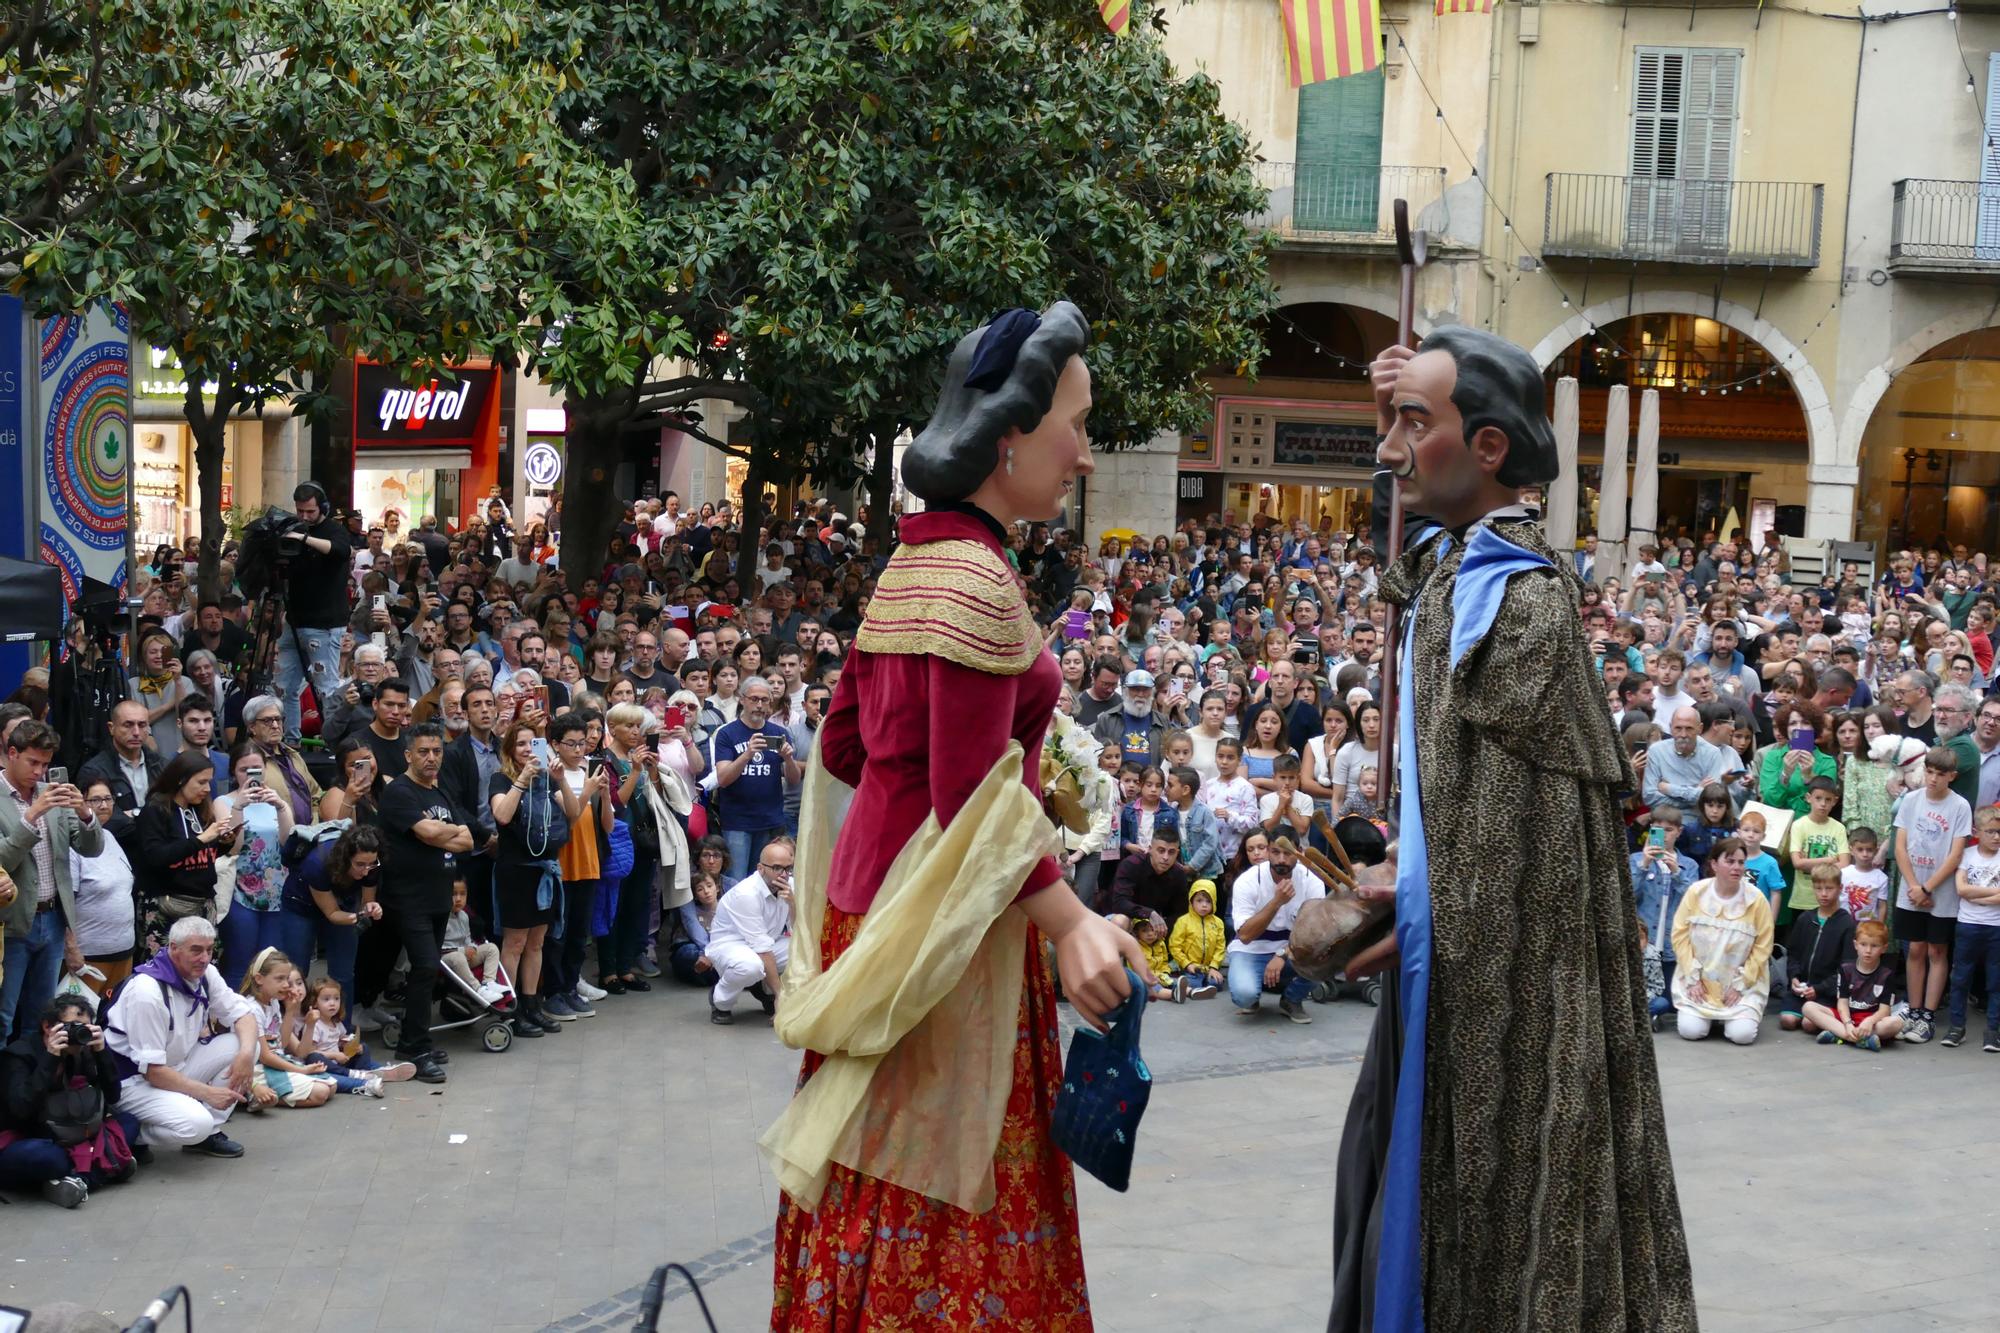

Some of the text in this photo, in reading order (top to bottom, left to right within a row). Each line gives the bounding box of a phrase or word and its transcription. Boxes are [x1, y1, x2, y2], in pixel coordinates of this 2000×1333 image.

[68, 350, 98, 380] FIRES
[97, 363, 123, 373] CIUTAT
[63, 372, 94, 414] FIGUERES
[379, 379, 471, 431] querol
[47, 391, 64, 436] CREU
[60, 415, 67, 431] DE
[46, 440, 59, 495] SANTA
[56, 432, 65, 472] CIUTAT
[62, 480, 92, 522] FIGUERES
[1181, 477, 1203, 498] BIBA
[55, 495, 68, 515] LA
[65, 514, 83, 533] DE
[82, 529, 120, 546] FESTES
[56, 541, 83, 588] SANTA
[58, 565, 77, 601] IUTAT
[741, 764, 771, 776] JETS
